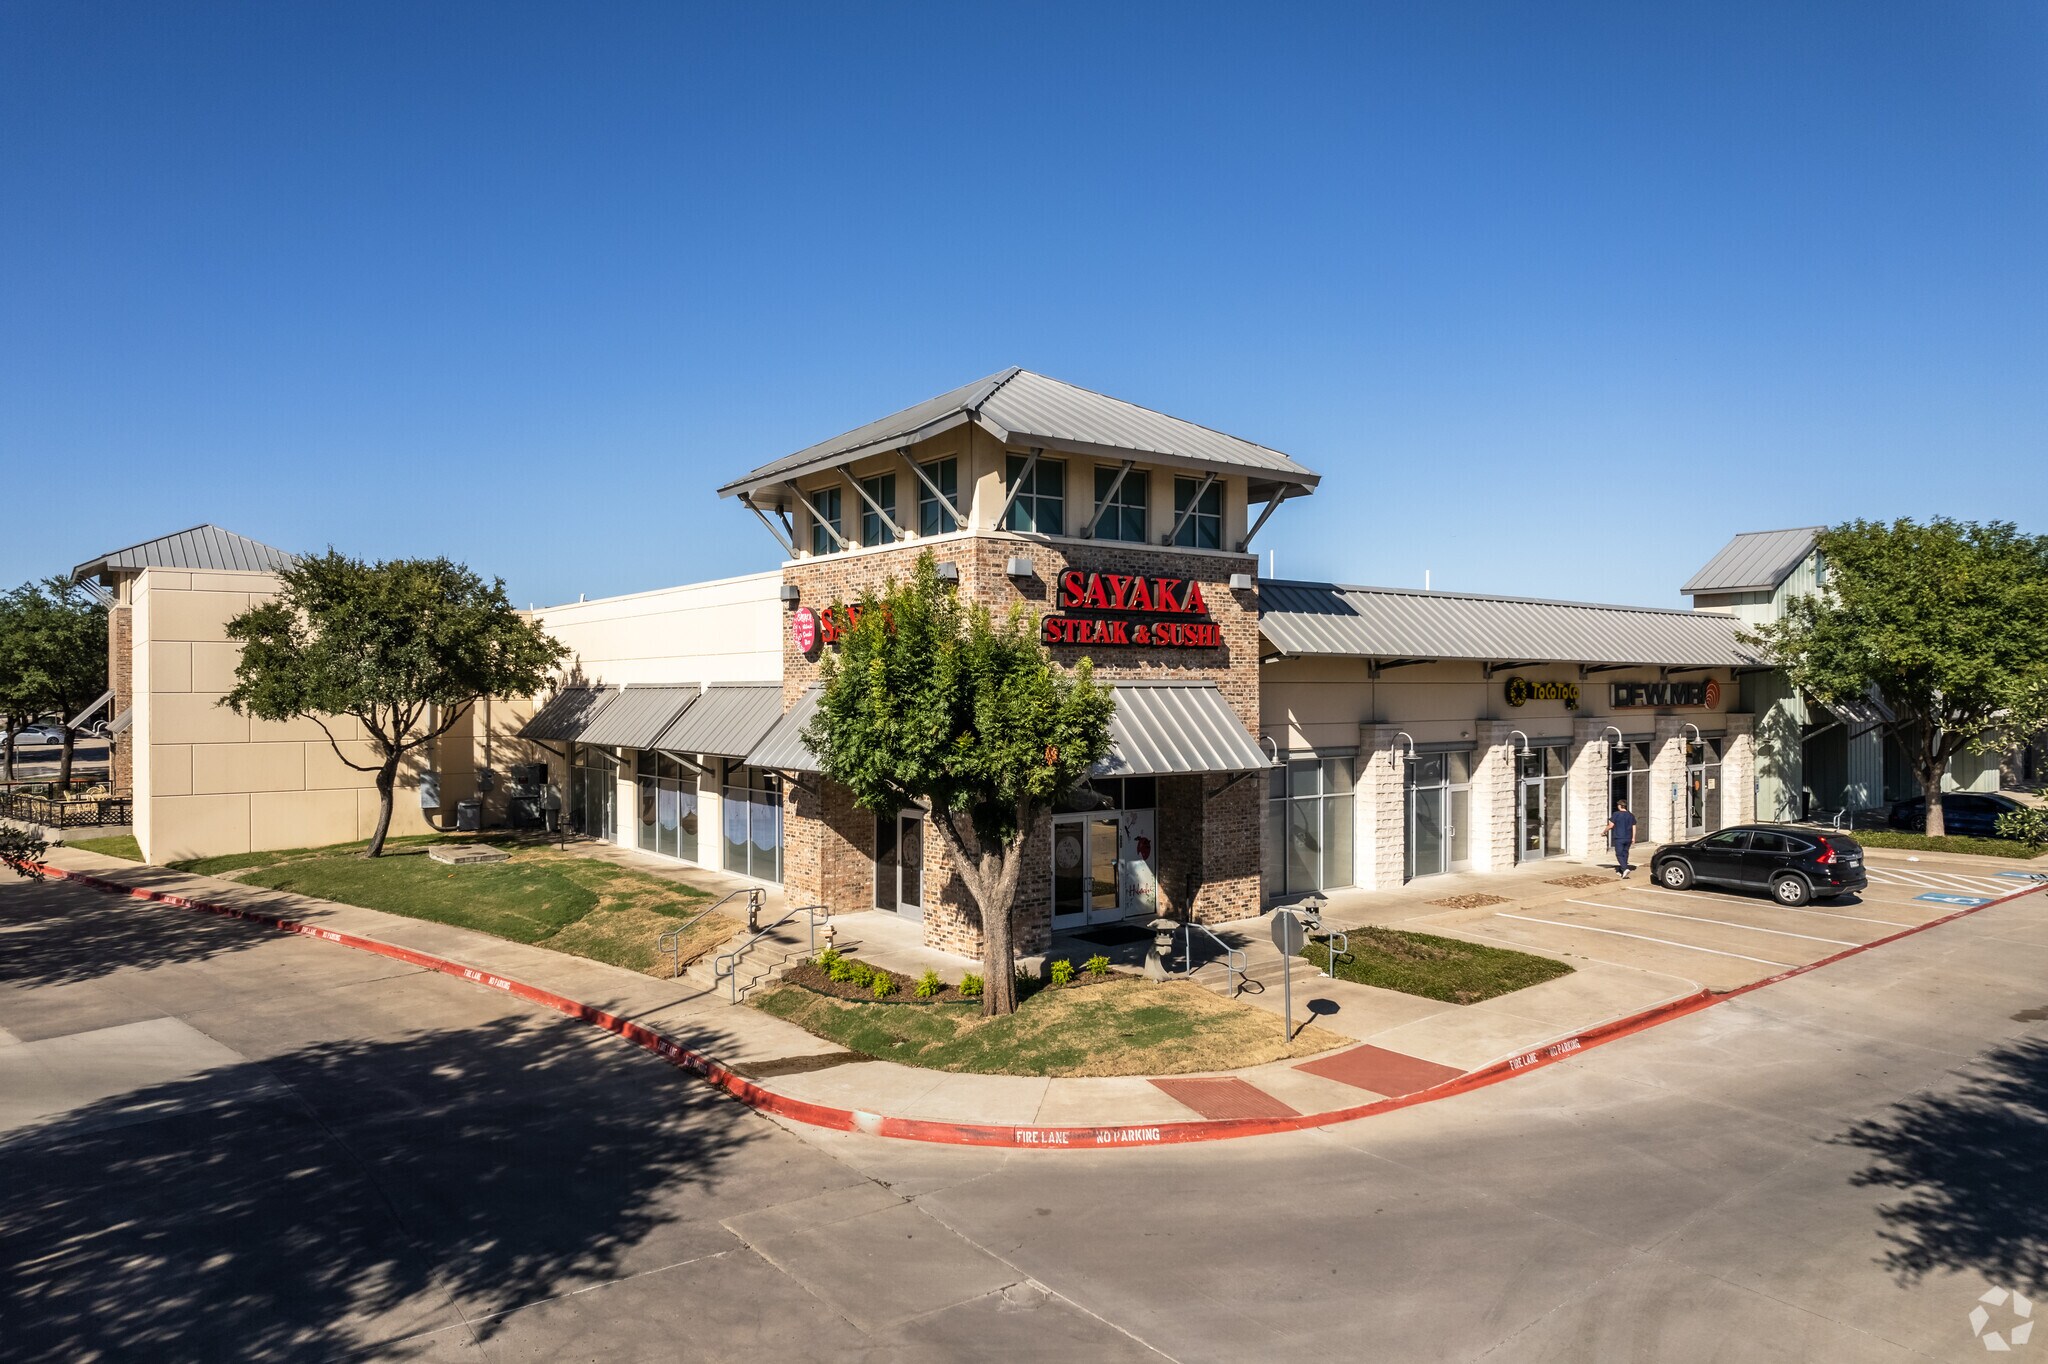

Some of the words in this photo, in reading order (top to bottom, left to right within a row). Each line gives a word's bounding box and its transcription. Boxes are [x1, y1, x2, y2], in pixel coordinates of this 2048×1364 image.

[1061, 571, 1208, 614] SAYAKA
[1044, 618, 1129, 645] STEAK
[1135, 624, 1151, 645] &
[1153, 622, 1221, 647] SUSHI
[1509, 1058, 1523, 1071] FIRE
[1522, 1053, 1538, 1066] LANE
[1549, 1047, 1558, 1057] NO
[1557, 1038, 1581, 1054] PARKING
[1016, 1131, 1039, 1143] FIRE
[1041, 1131, 1069, 1144] LANE
[1097, 1131, 1111, 1144] NO
[1114, 1128, 1160, 1142] PARKING
